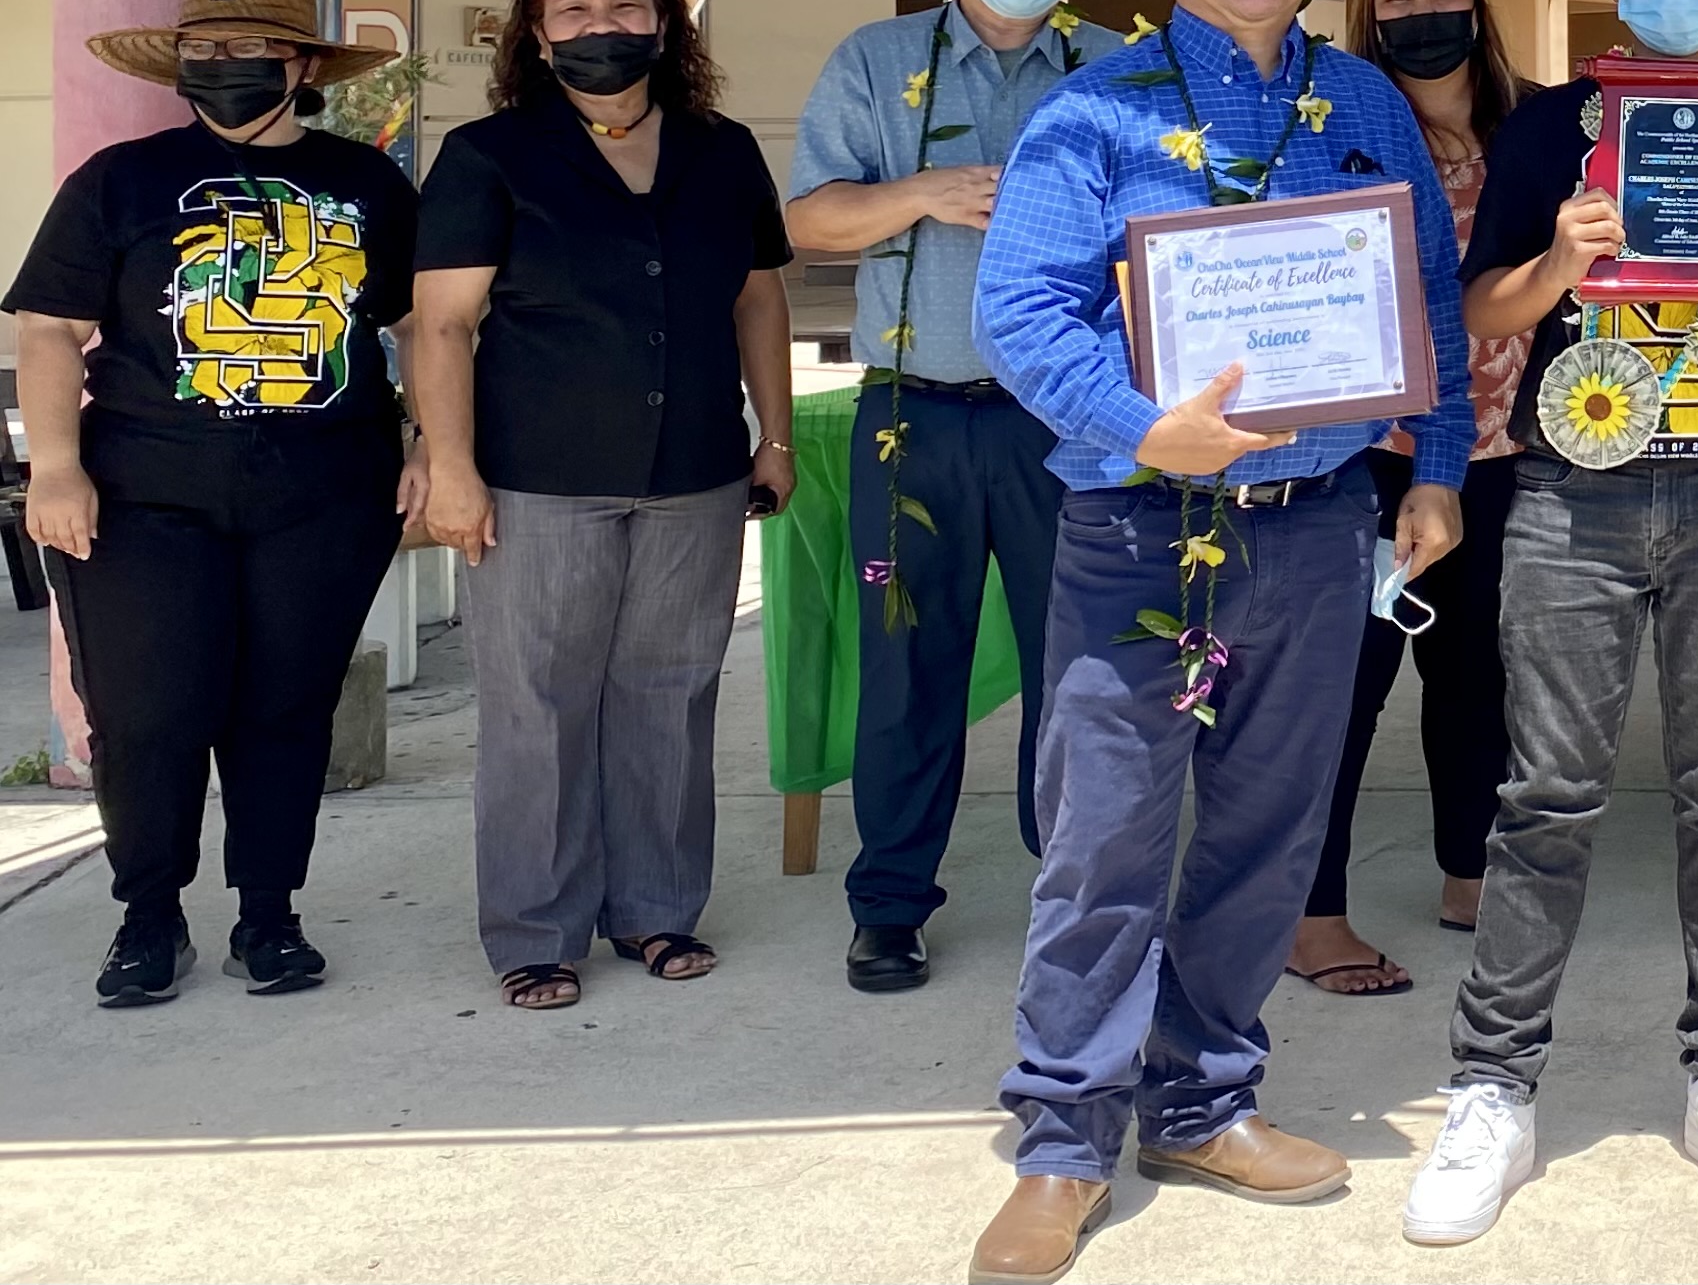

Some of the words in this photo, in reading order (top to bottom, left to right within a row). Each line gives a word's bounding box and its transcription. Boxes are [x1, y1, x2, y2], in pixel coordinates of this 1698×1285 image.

[448, 52, 496, 63] CAFETE
[1192, 270, 1261, 298] Certificate
[1267, 268, 1283, 290] of
[1287, 260, 1356, 287] Excellence
[1247, 328, 1311, 349] Science
[1671, 443, 1685, 452] OF
